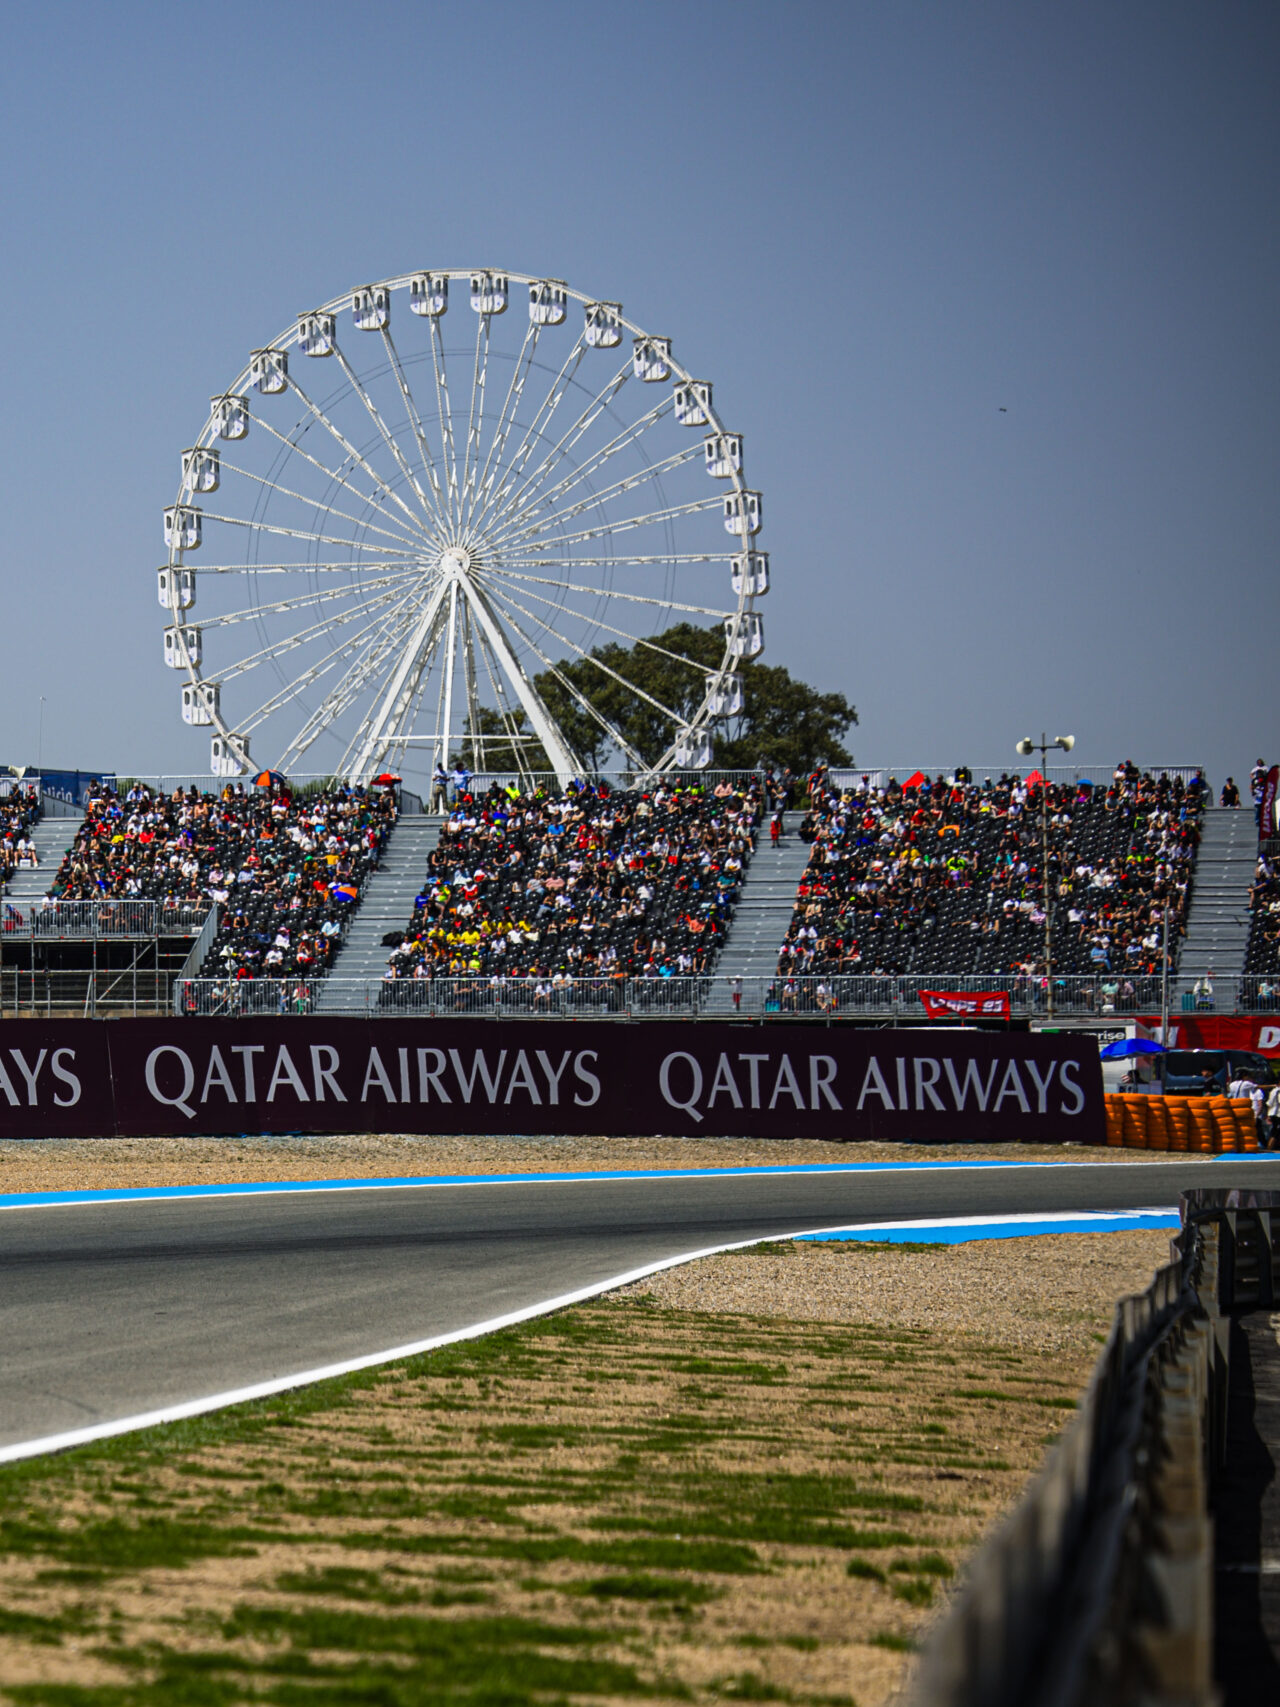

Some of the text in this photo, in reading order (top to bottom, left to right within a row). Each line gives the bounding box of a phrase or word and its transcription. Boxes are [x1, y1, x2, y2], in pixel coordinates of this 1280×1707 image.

[144, 1044, 601, 1120] QATAR AIRWAYS
[659, 1051, 1084, 1123] QATAR AIRWAYS
